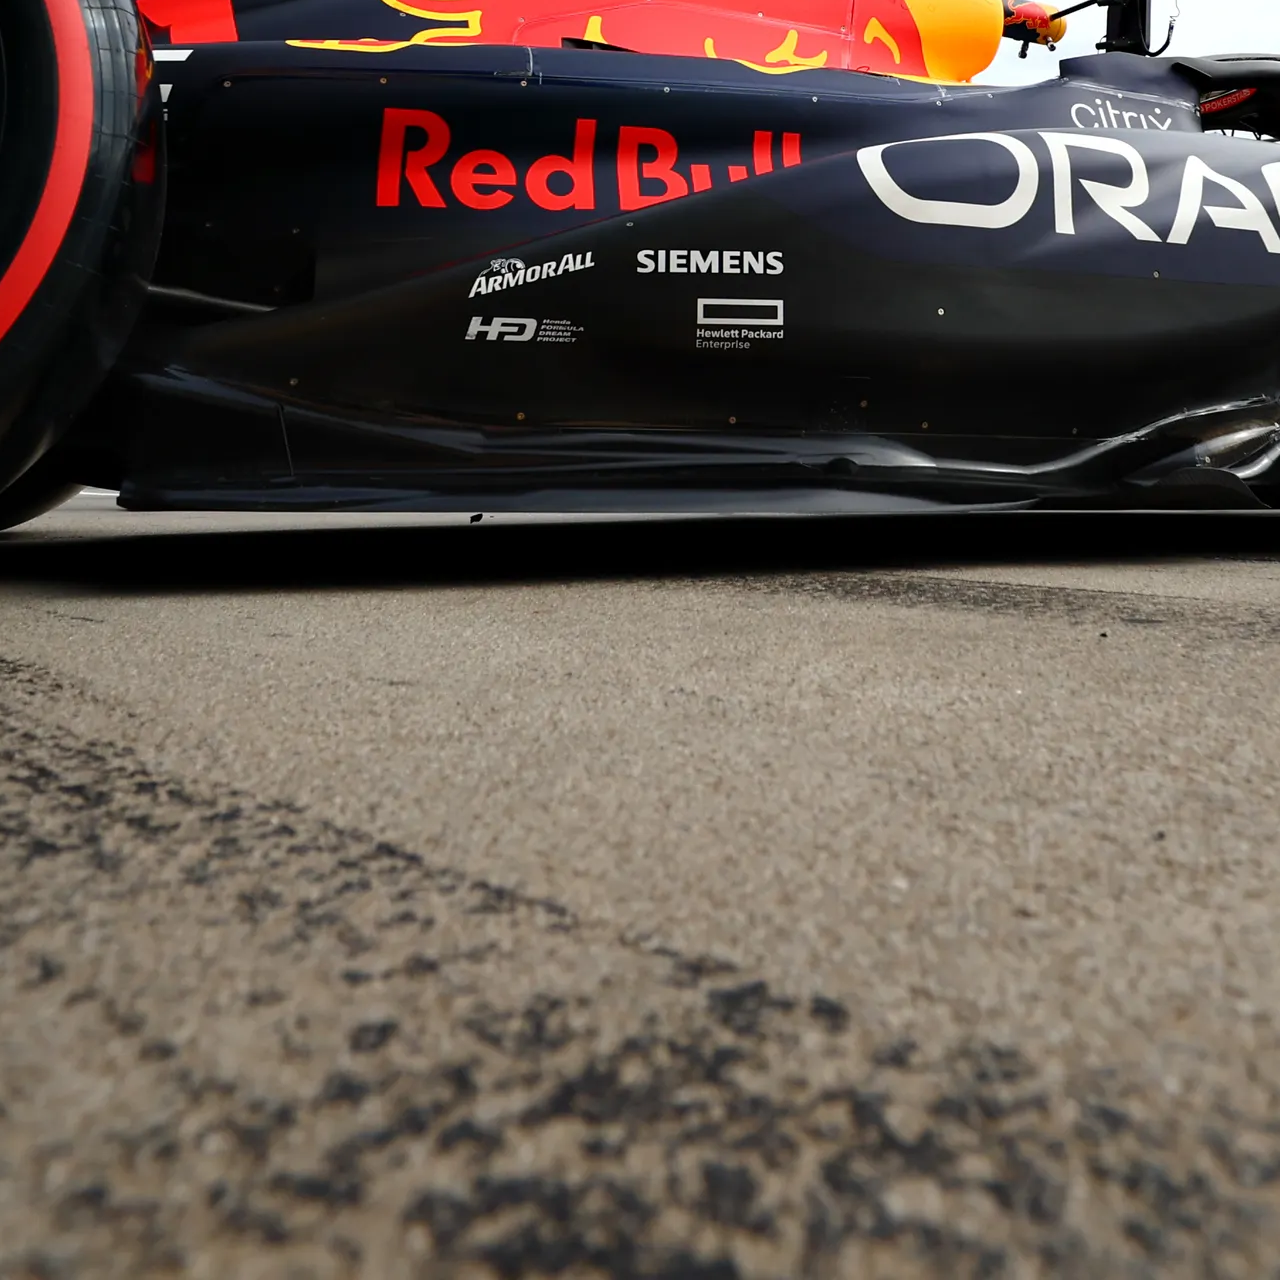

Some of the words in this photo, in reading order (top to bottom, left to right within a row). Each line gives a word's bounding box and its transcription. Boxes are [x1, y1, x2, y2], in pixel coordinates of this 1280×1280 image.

[376, 107, 597, 211] Red
[636, 249, 784, 275] SIEMENS
[696, 328, 739, 339] Hewlett
[741, 329, 784, 340] Packard
[695, 338, 751, 351] Enterprise
